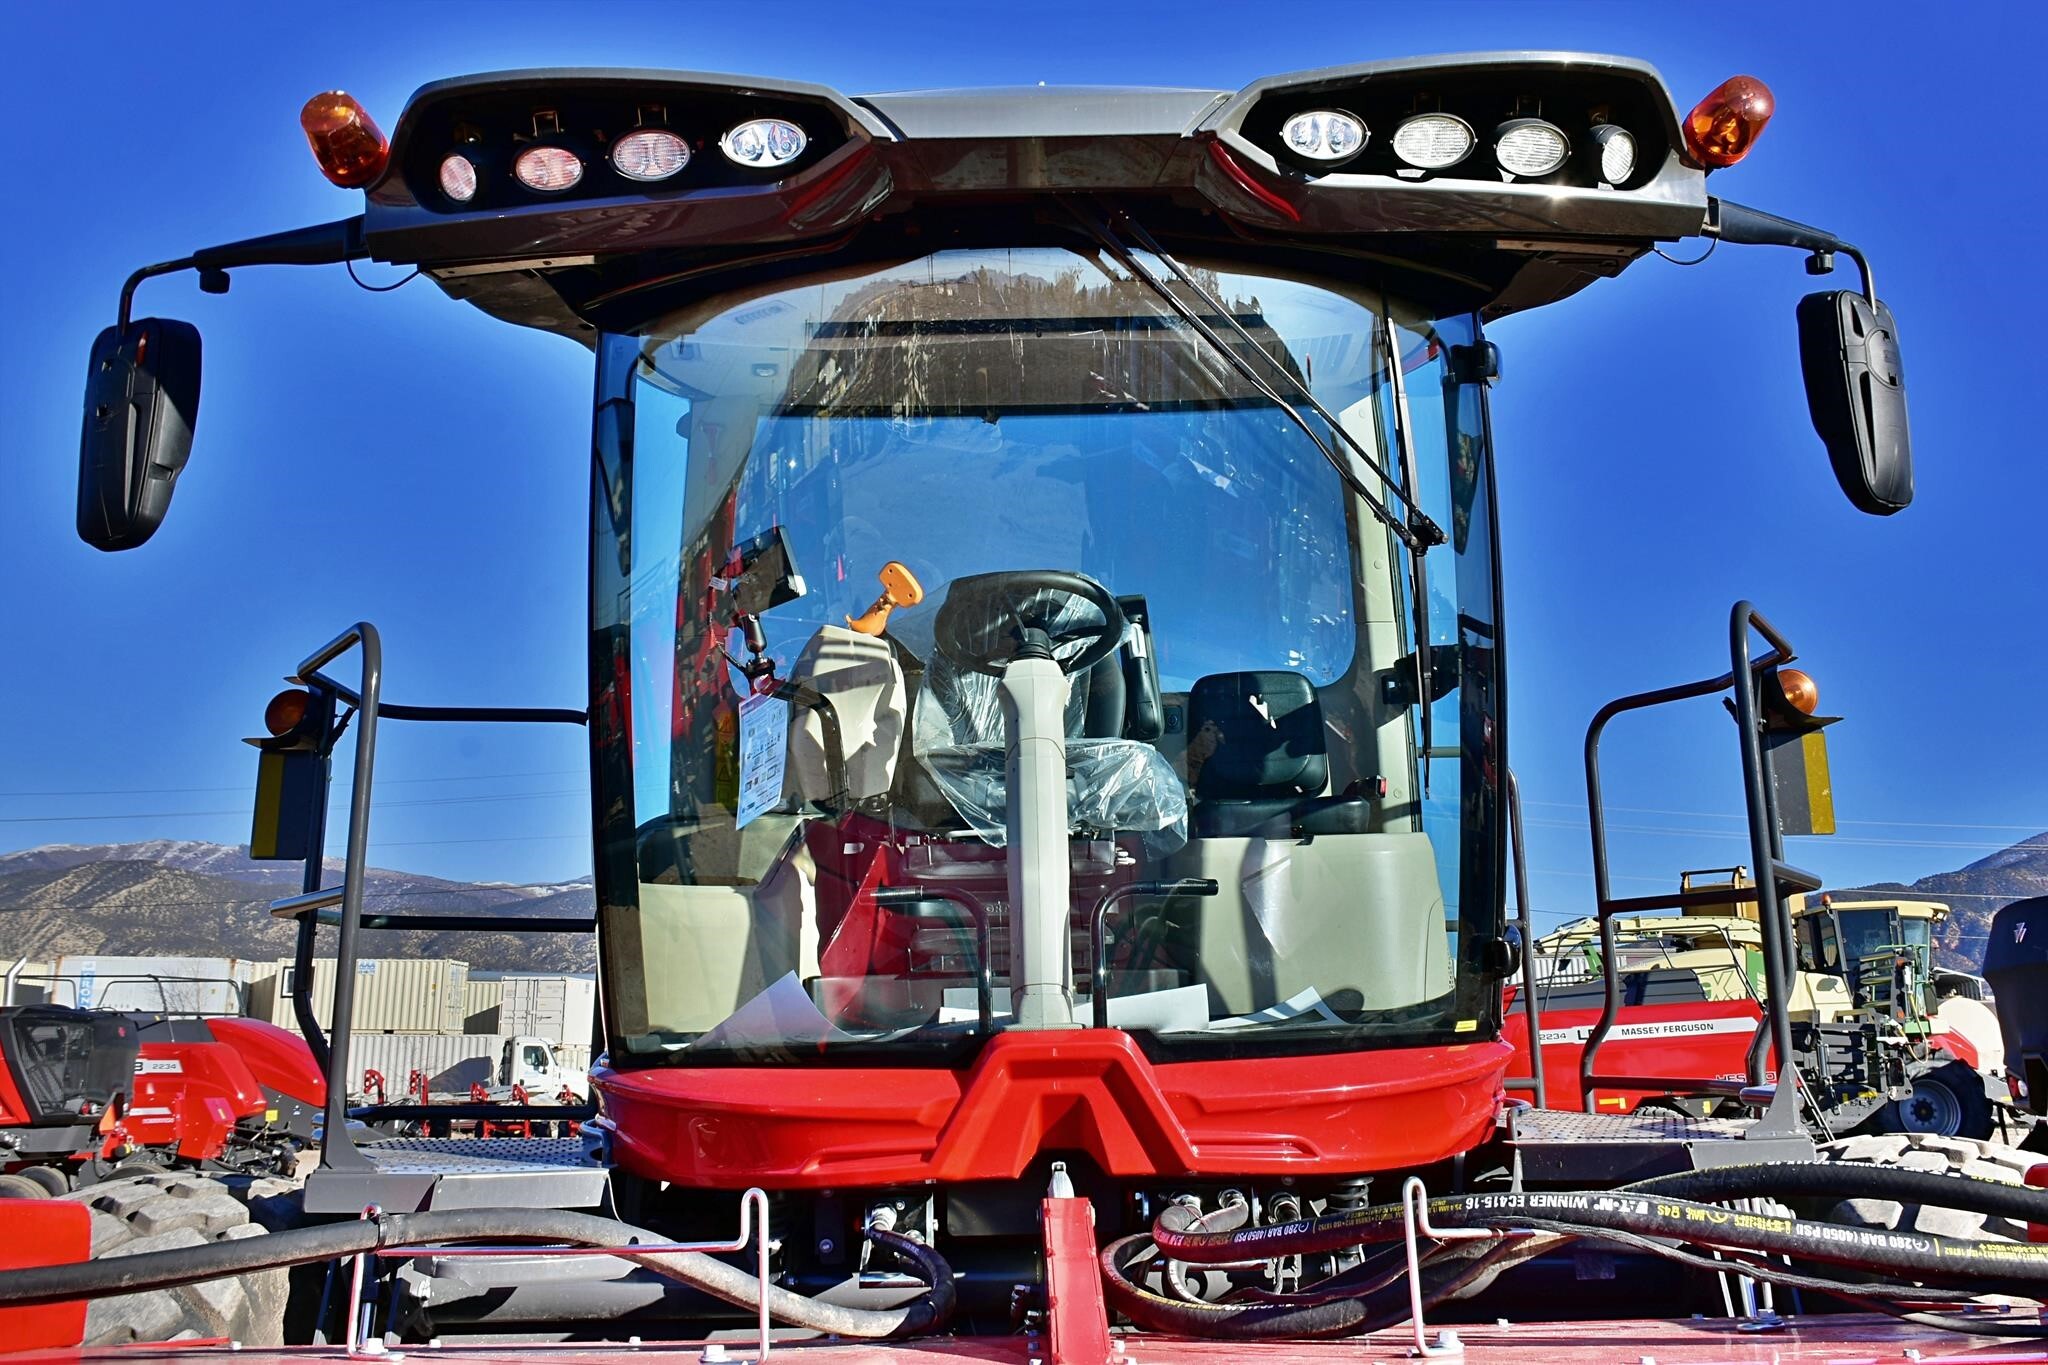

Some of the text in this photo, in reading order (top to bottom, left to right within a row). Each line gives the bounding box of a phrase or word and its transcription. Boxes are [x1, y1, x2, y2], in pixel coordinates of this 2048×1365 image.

[1539, 1032, 1567, 1041] 2234
[1621, 1023, 1714, 1036] MASSEY FERGUSON
[1465, 1195, 1526, 1210] EC415-16
[1529, 1195, 1589, 1210] WINNER
[1267, 1226, 1284, 1238] BAR
[1822, 1228, 1859, 1242] (4050
[1860, 1232, 1887, 1247] BAR
[1889, 1236, 1914, 1250] 280
